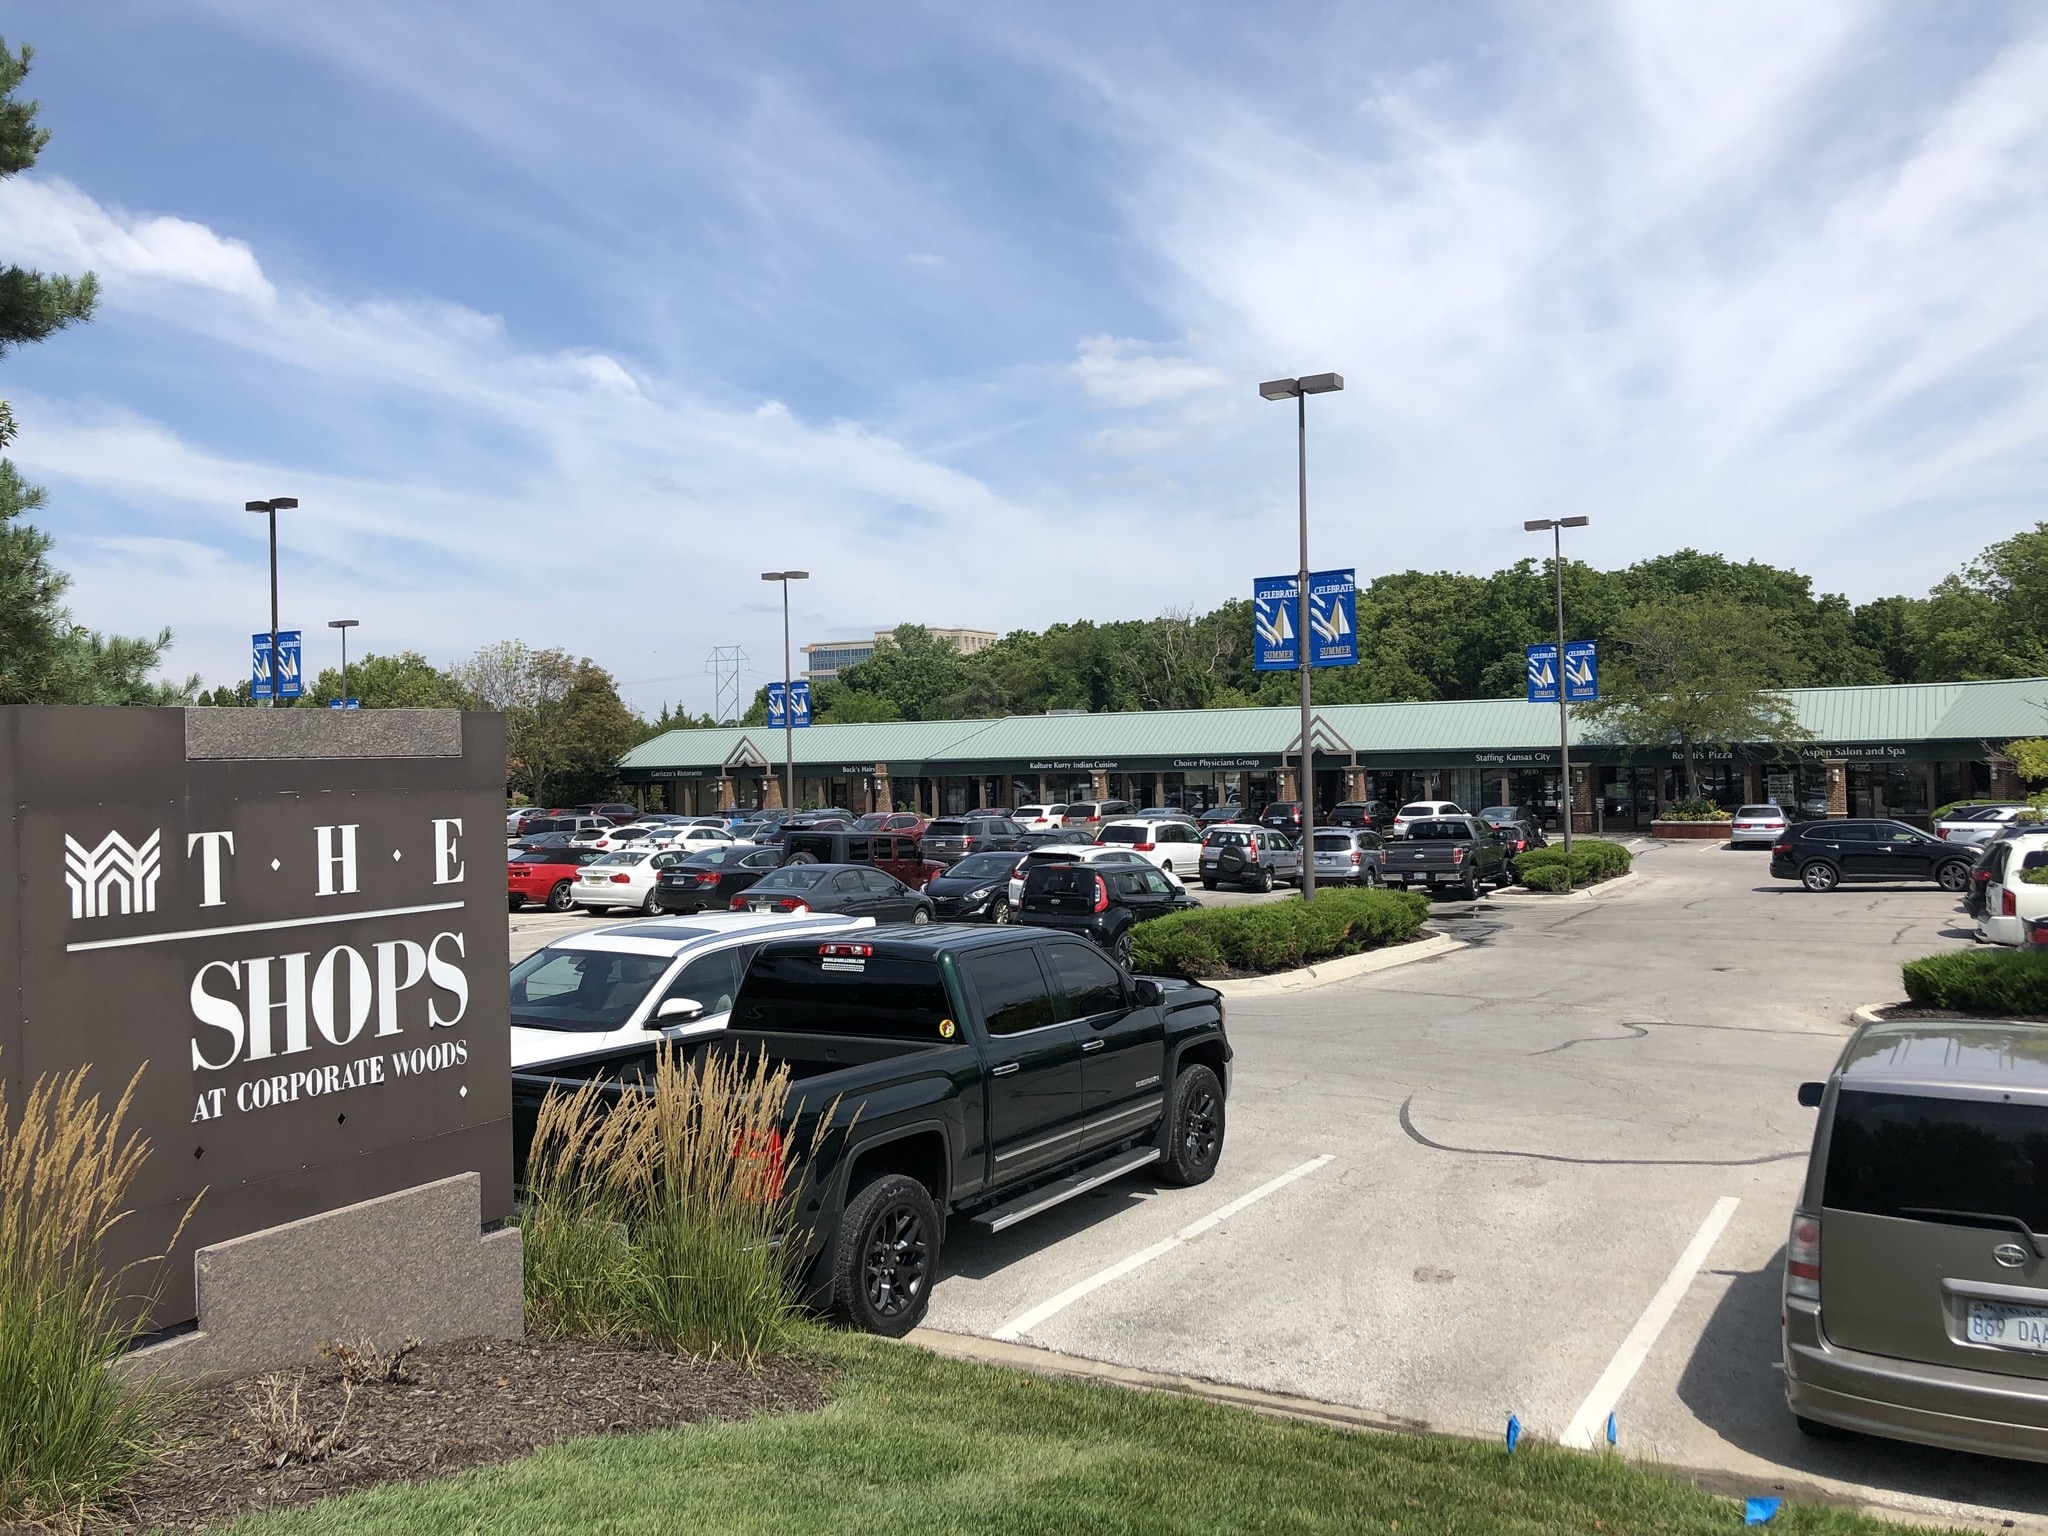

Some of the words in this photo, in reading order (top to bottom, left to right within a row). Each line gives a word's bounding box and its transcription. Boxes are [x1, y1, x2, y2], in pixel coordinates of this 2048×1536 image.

[1259, 589, 1298, 600] CELEBRATE
[1314, 583, 1354, 595] CELEBRATE
[1263, 650, 1294, 659] SUMMER
[1320, 645, 1351, 656] SUMMER
[1475, 753, 1504, 763] Staffing
[1506, 753, 1532, 761] Kansas
[1534, 752, 1551, 762] City
[1672, 750, 1704, 760] Roti's
[1708, 750, 1733, 759] Pizza
[1801, 748, 1832, 759] Aspen
[1834, 747, 1863, 756] Salon
[1865, 746, 1884, 756] and
[1887, 746, 1906, 757] Spa
[1029, 761, 1053, 769] Kulture
[1053, 761, 1072, 770] Kurry
[1073, 761, 1093, 769] Indian
[1094, 760, 1118, 769] Cuisine
[1173, 759, 1198, 767] Choice
[1199, 759, 1235, 768] Physicians
[1236, 758, 1260, 767] Group
[190, 931, 469, 1072] SHOPS
[191, 1088, 226, 1123] AT
[236, 1055, 385, 1112] CORPORATE
[391, 1039, 468, 1079] WOODS
[1973, 1314, 2006, 1338] 869
